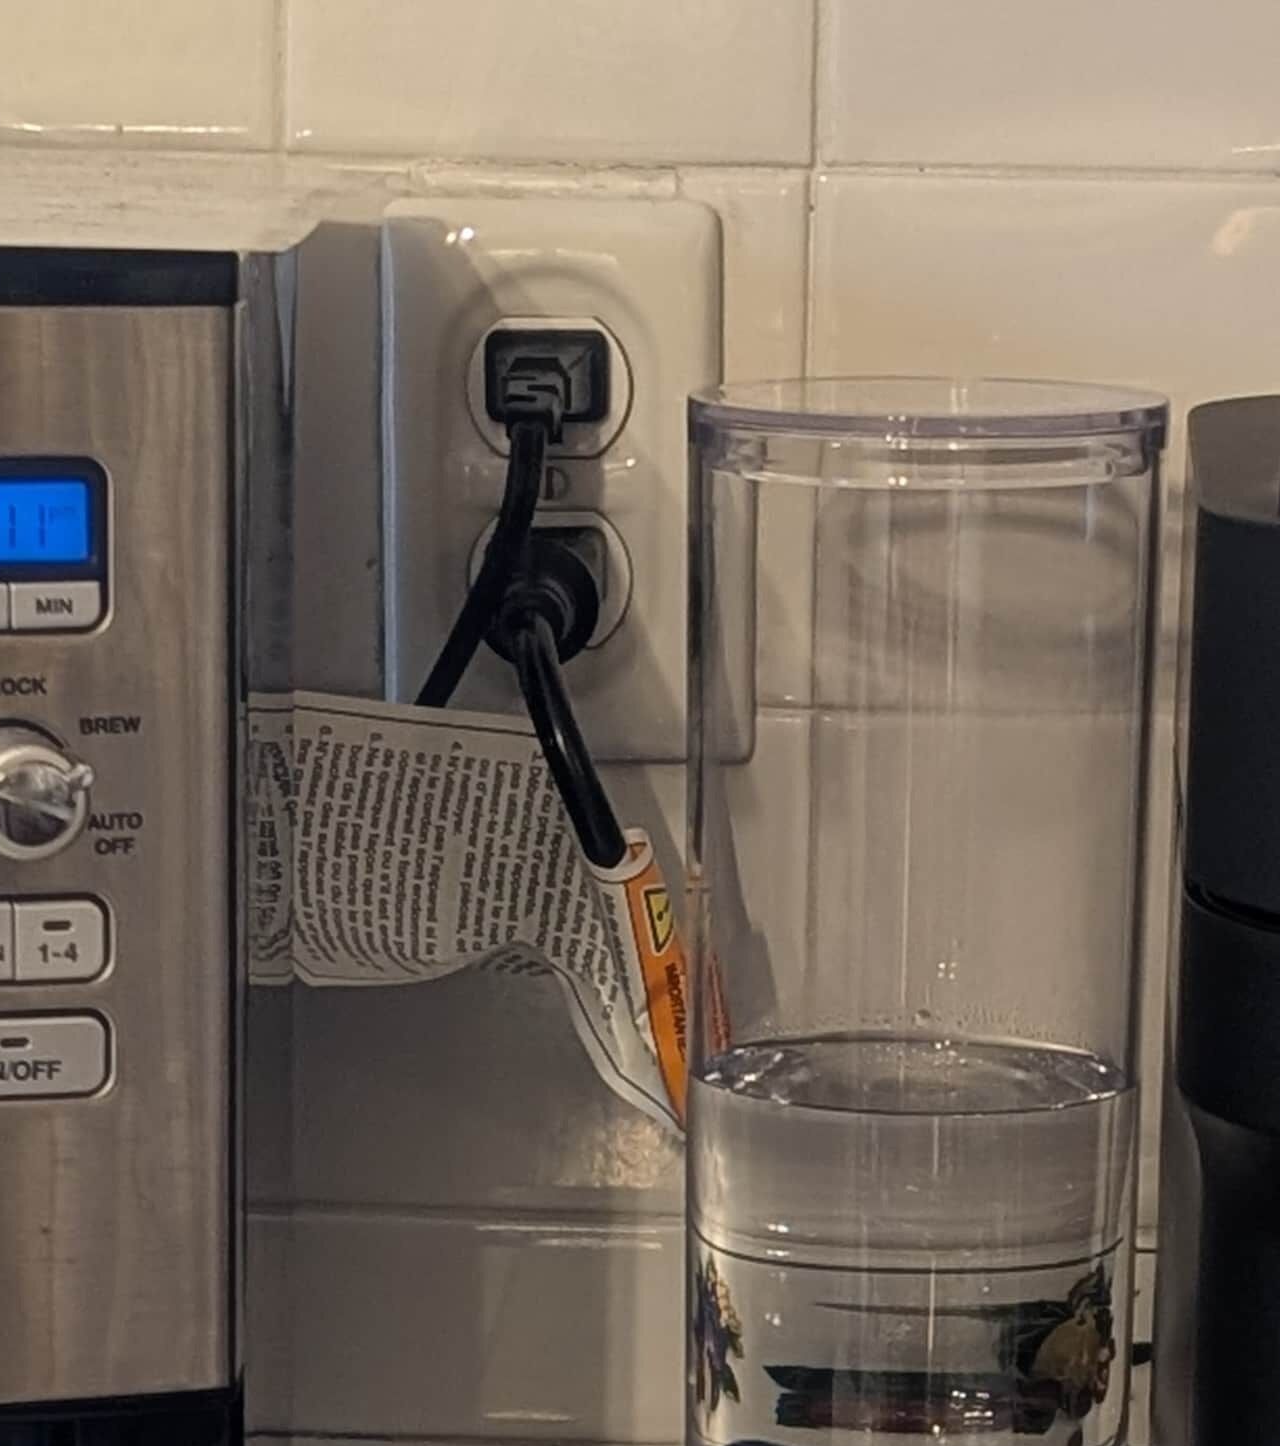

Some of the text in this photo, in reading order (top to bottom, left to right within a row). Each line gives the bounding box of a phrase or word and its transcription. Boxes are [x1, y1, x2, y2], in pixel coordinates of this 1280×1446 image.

[35, 597, 74, 615] MIN
[78, 715, 143, 735] BREW
[87, 811, 144, 832] AUTO
[93, 836, 136, 856] OFF
[37, 942, 79, 963] 1-4
